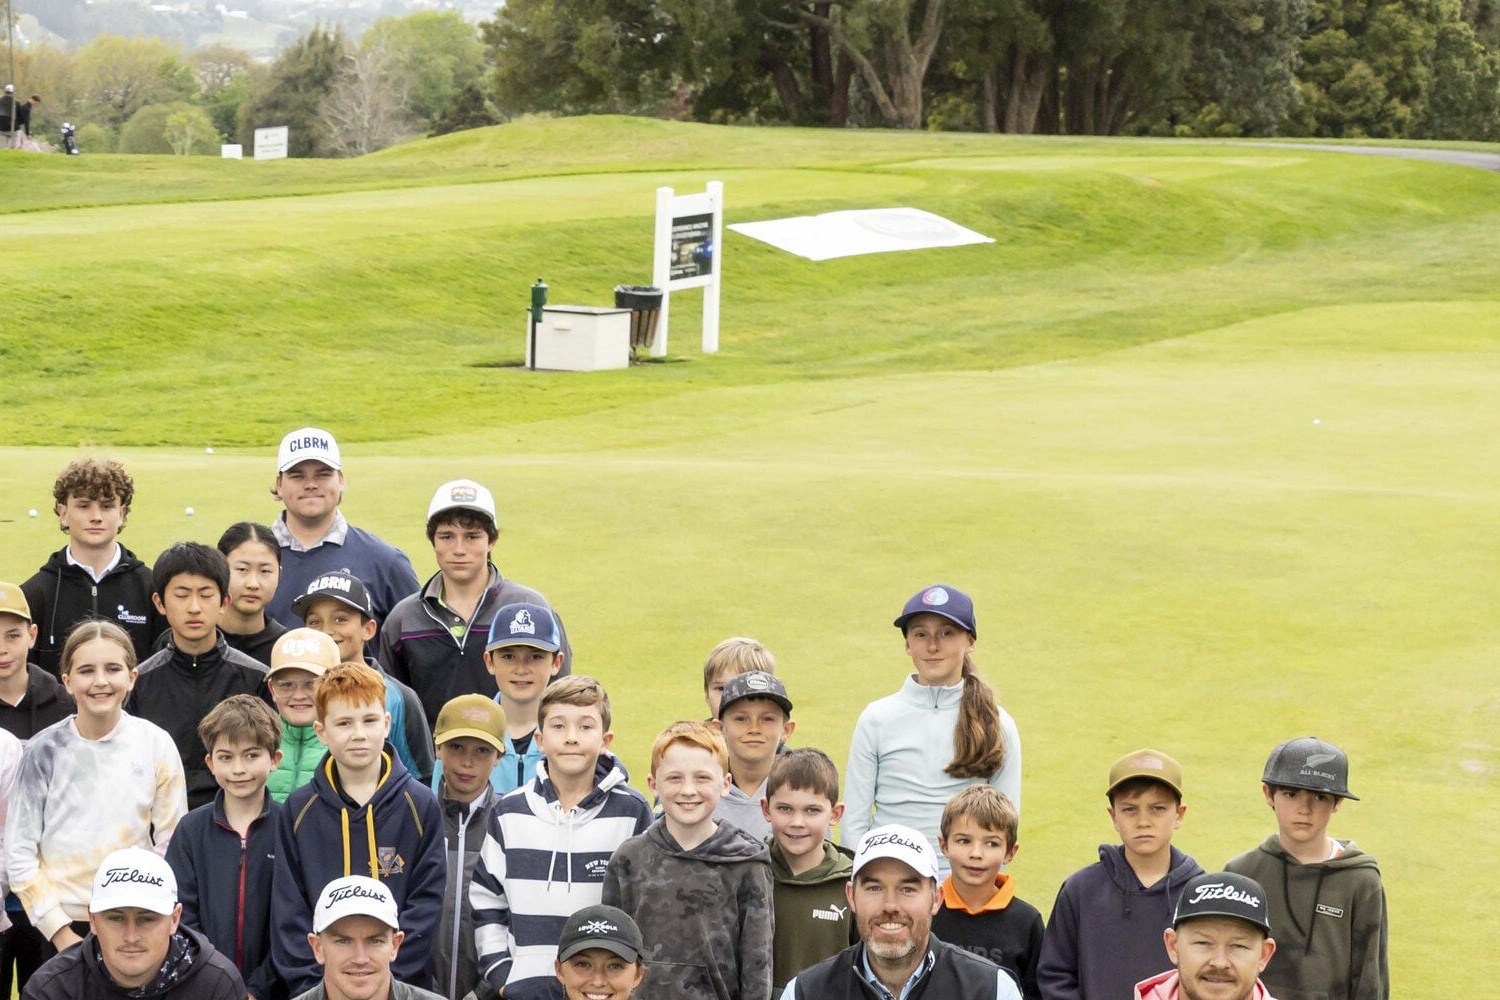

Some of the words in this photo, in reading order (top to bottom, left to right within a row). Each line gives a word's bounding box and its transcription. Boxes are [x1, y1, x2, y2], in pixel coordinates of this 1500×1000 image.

[289, 436, 329, 452] CLBRM
[308, 576, 352, 596] CLBRM
[861, 832, 924, 855] Titleist
[585, 860, 599, 870] NEW
[101, 867, 165, 888] Titleist
[325, 883, 387, 909] Titleist
[1189, 882, 1261, 908] Titleist
[812, 908, 839, 921] PUMA
